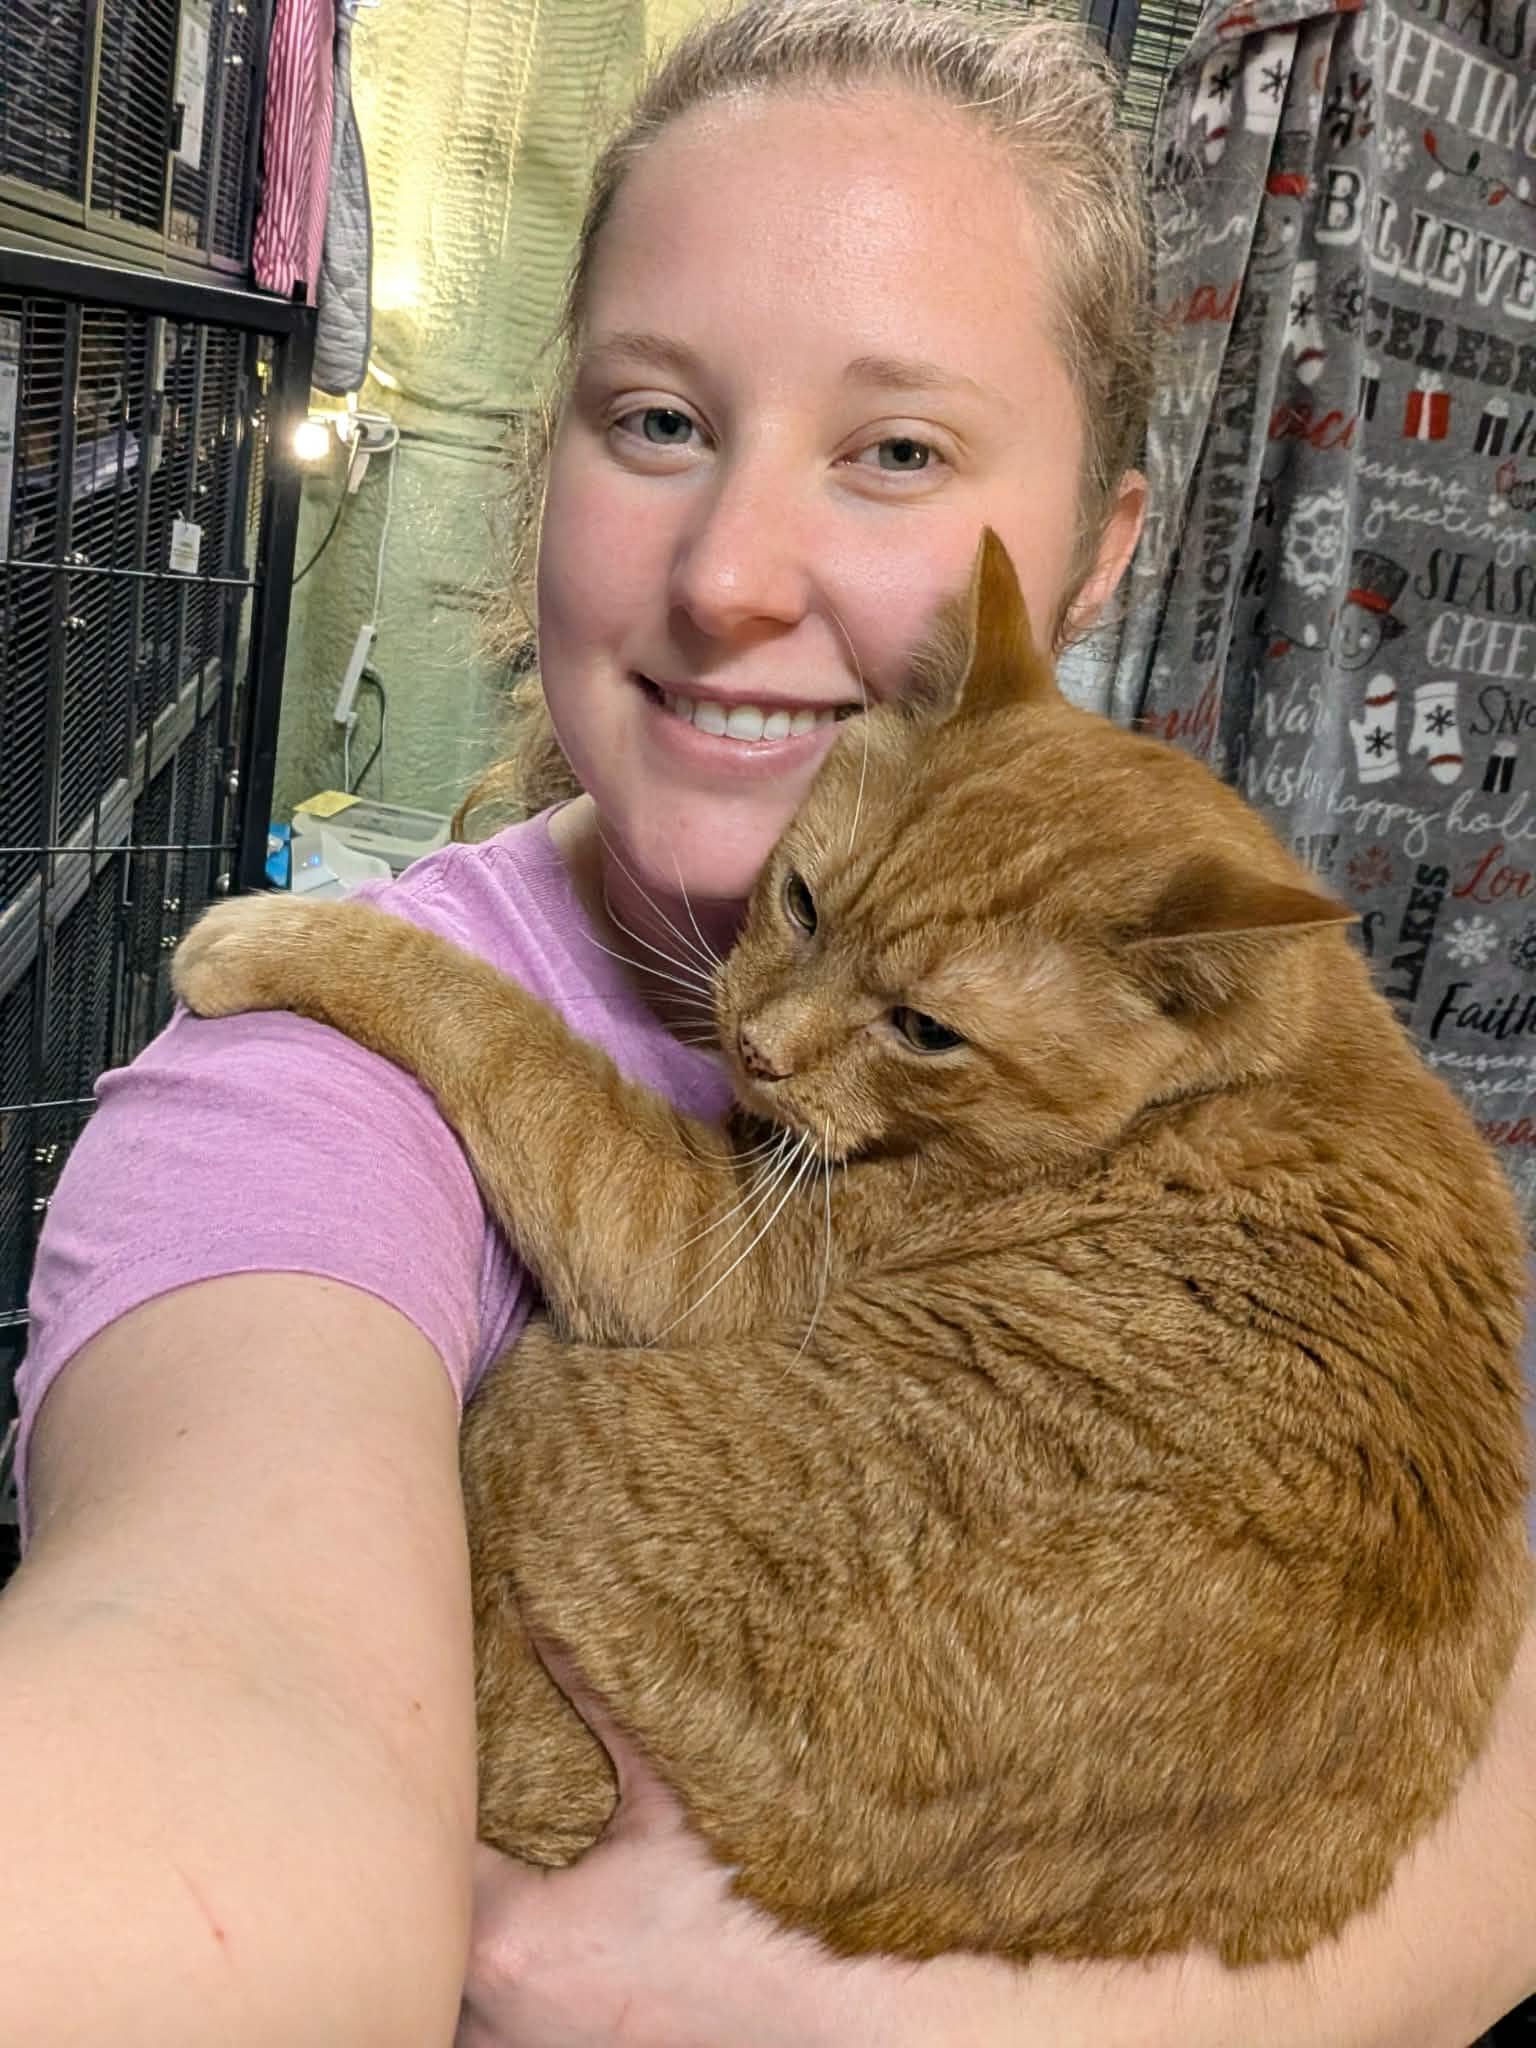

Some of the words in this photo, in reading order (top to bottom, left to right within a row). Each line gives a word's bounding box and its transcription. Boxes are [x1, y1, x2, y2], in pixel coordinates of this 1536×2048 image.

[1314, 164, 1536, 322] BLIEVE
[1413, 548, 1536, 616] SEAS
[1426, 611, 1536, 680] GREE
